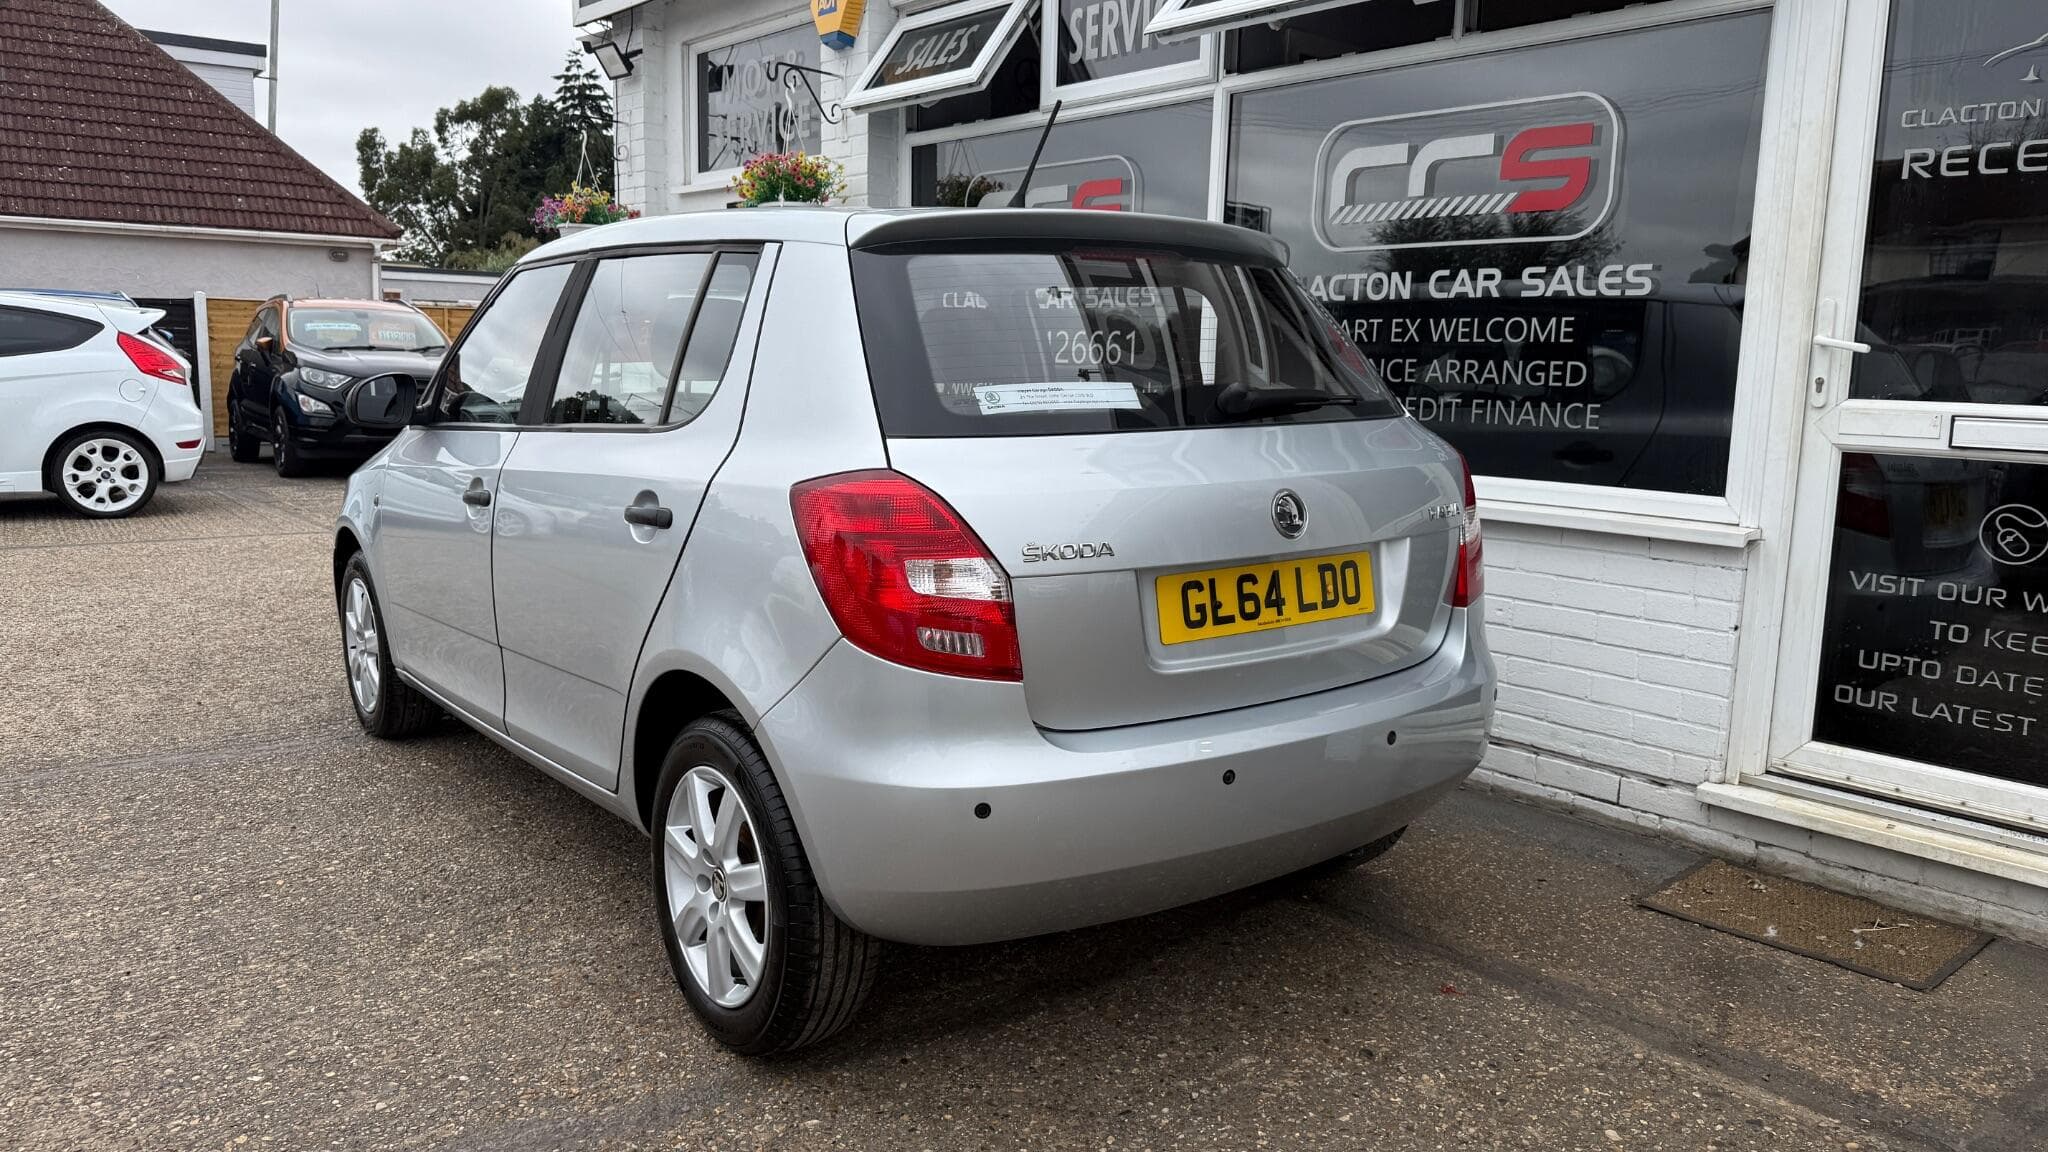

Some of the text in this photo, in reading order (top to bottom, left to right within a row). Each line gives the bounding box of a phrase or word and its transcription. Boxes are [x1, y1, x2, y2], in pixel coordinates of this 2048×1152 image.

[894, 24, 980, 75] SALES
[1069, 0, 1165, 64] SERVI
[1901, 99, 2041, 128] CLACTON
[1901, 139, 2048, 180] RECE
[1085, 286, 1157, 309] SALES
[1309, 263, 1653, 302] ACTON CAR SALES
[1047, 330, 1136, 366] 26661
[1340, 316, 1575, 343] ART EX WELCOME
[1425, 359, 1588, 388] ARRANGED
[1404, 397, 1601, 430] EDIT FINANCE
[1022, 541, 1115, 563] ŠKODA
[1181, 559, 1362, 630] GL64 LDO
[1850, 570, 1926, 598] VISIT
[1937, 582, 2007, 609] OUR
[1929, 620, 2048, 656] TO KEE
[1858, 649, 2045, 697] UPTO DATE
[1834, 684, 2038, 736] OUR LATEST
